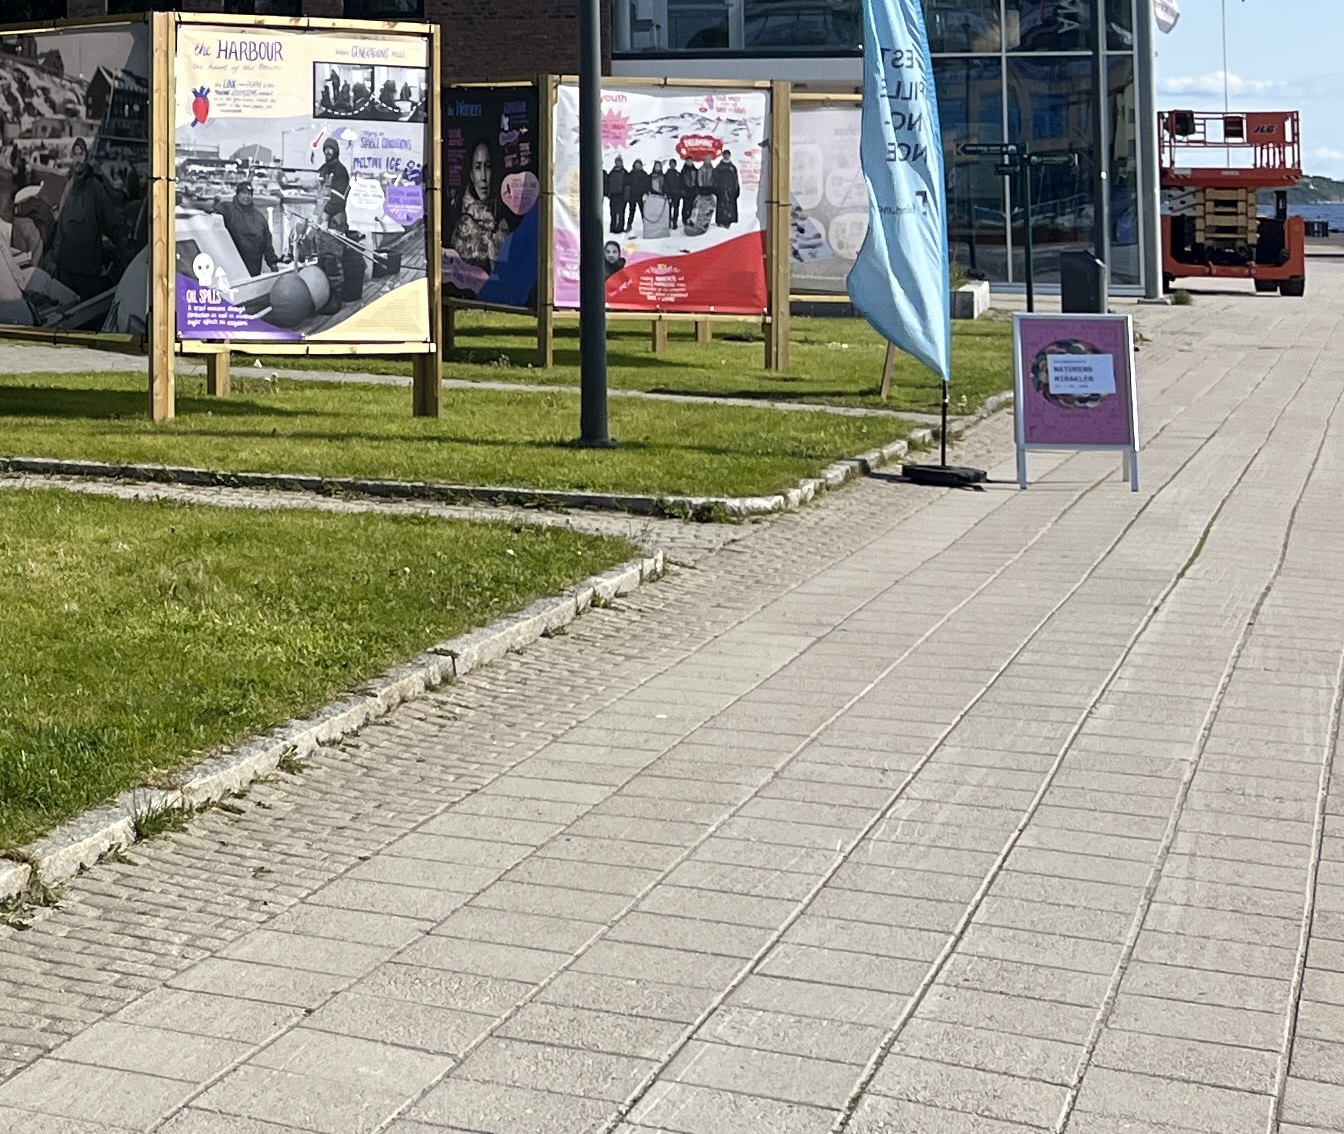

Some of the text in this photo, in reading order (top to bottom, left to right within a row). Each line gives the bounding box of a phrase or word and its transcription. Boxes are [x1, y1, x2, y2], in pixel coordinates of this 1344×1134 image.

[195, 40, 283, 61] the HARBOUR
[601, 94, 627, 103] youth
[1252, 125, 1276, 134] JLG
[386, 157, 402, 171] ICE
[186, 289, 222, 304] OIL SPILLS
